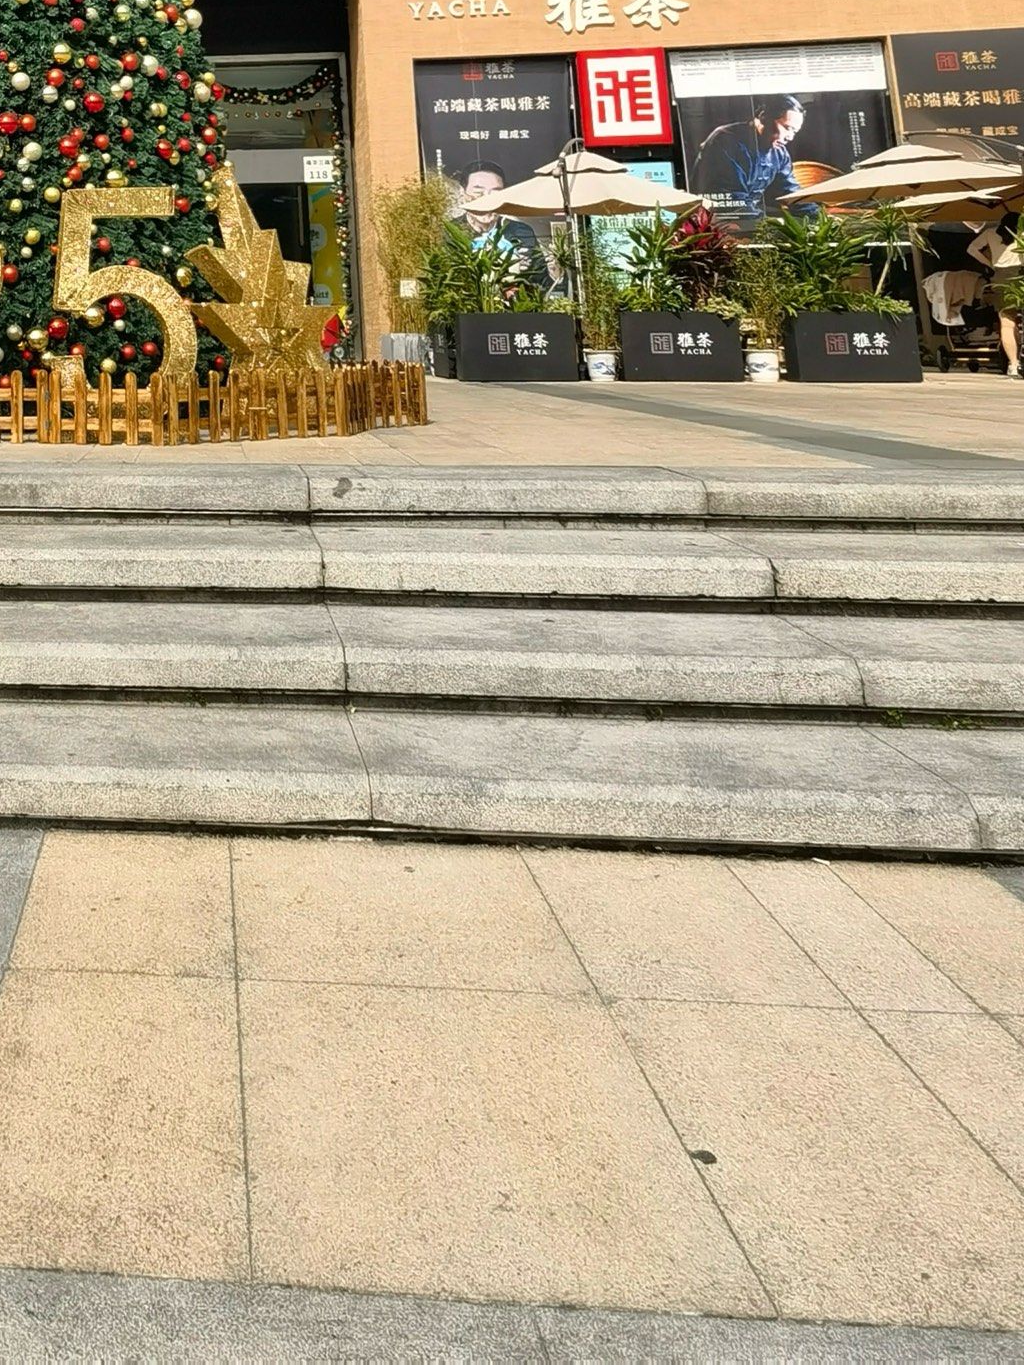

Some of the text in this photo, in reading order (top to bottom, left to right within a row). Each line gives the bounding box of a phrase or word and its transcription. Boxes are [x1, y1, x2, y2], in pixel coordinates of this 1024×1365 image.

[961, 49, 997, 64] 雅茶
[903, 88, 1024, 109] 高端藏茶喝雅
[513, 332, 549, 348] 雅茶
[676, 332, 714, 348] 雅茶
[852, 332, 891, 348] 雅茶
[856, 348, 889, 356] YACHA
